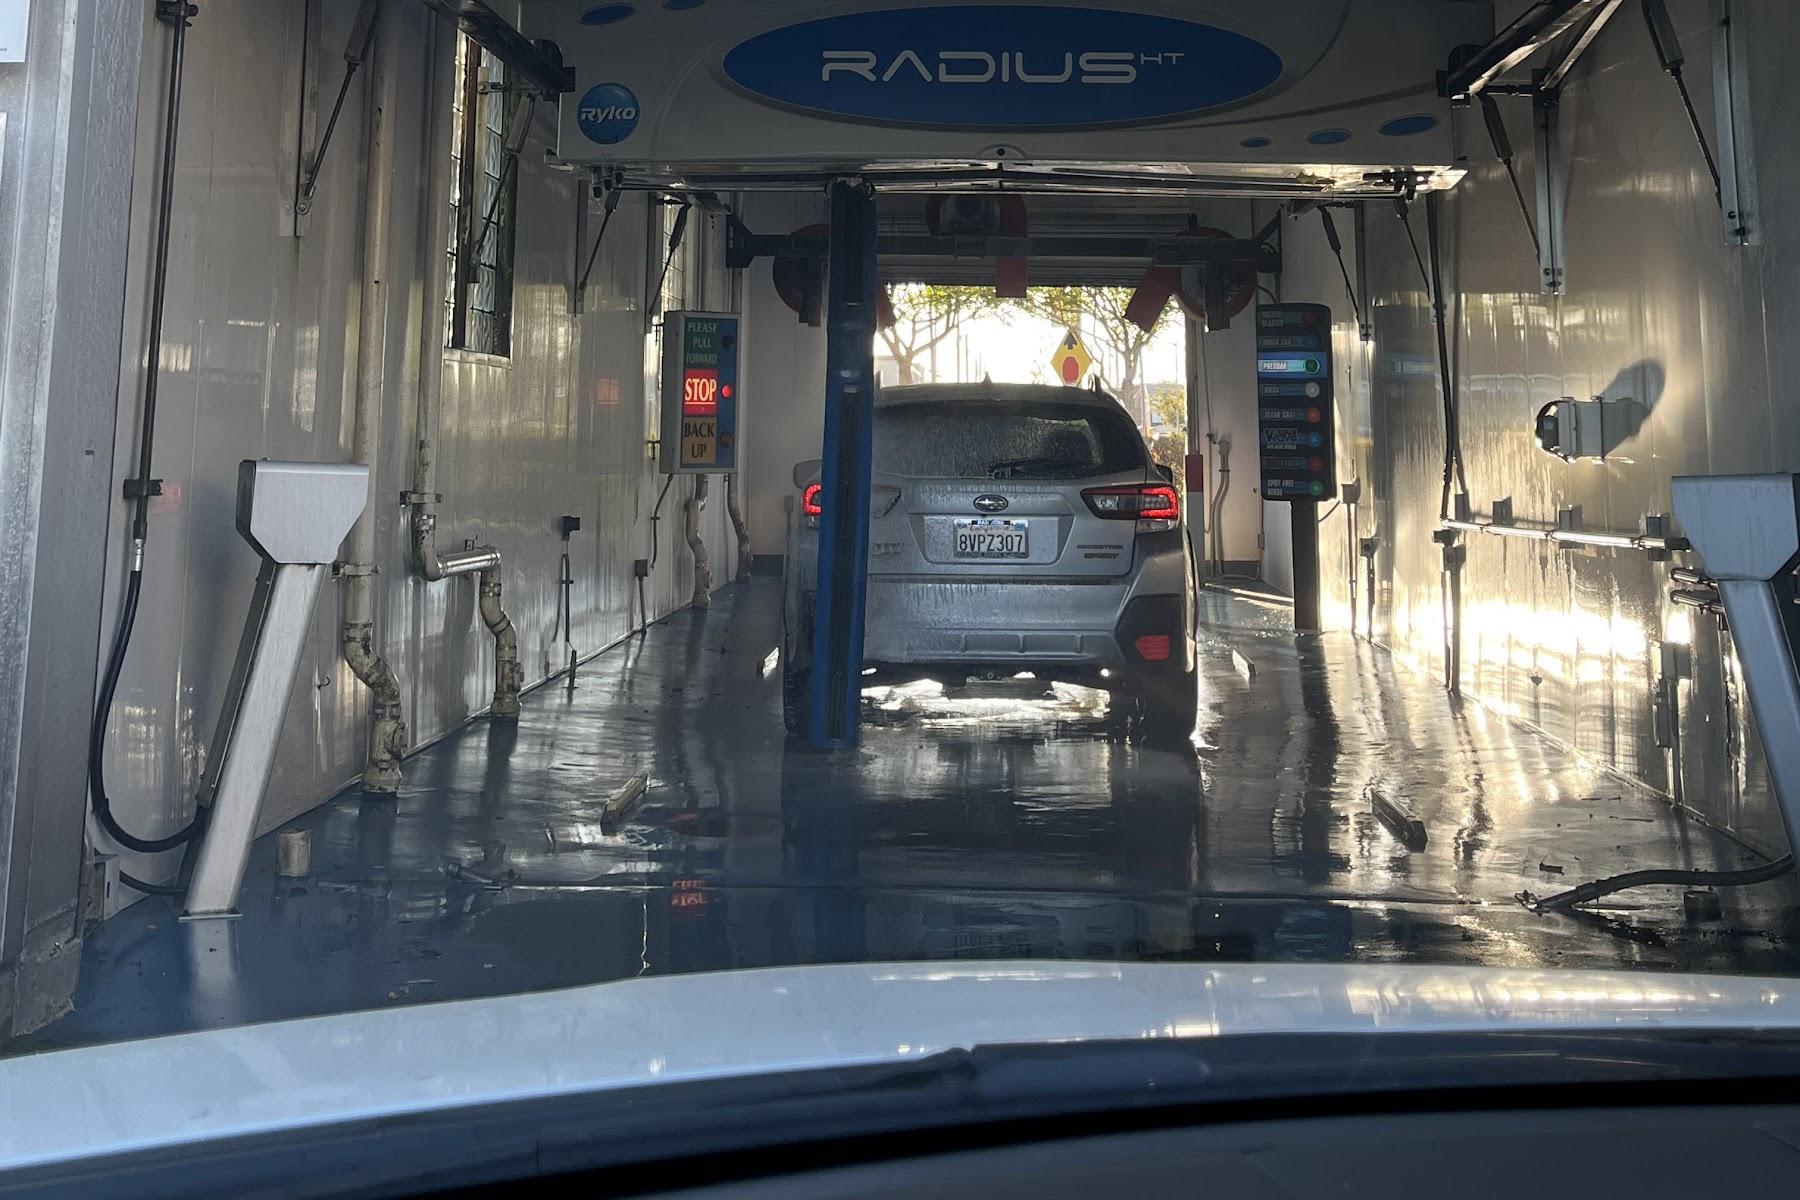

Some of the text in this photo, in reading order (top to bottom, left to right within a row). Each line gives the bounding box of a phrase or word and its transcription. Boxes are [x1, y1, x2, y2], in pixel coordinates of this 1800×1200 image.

[822, 50, 1137, 83] RADIUS
[687, 321, 718, 333] PLEASE
[693, 337, 712, 349] PULL
[686, 353, 718, 365] FORWARD
[684, 377, 717, 402] STOP
[684, 422, 715, 438] BACK
[691, 443, 707, 459] UP
[959, 533, 1023, 552] 8VPZ307
